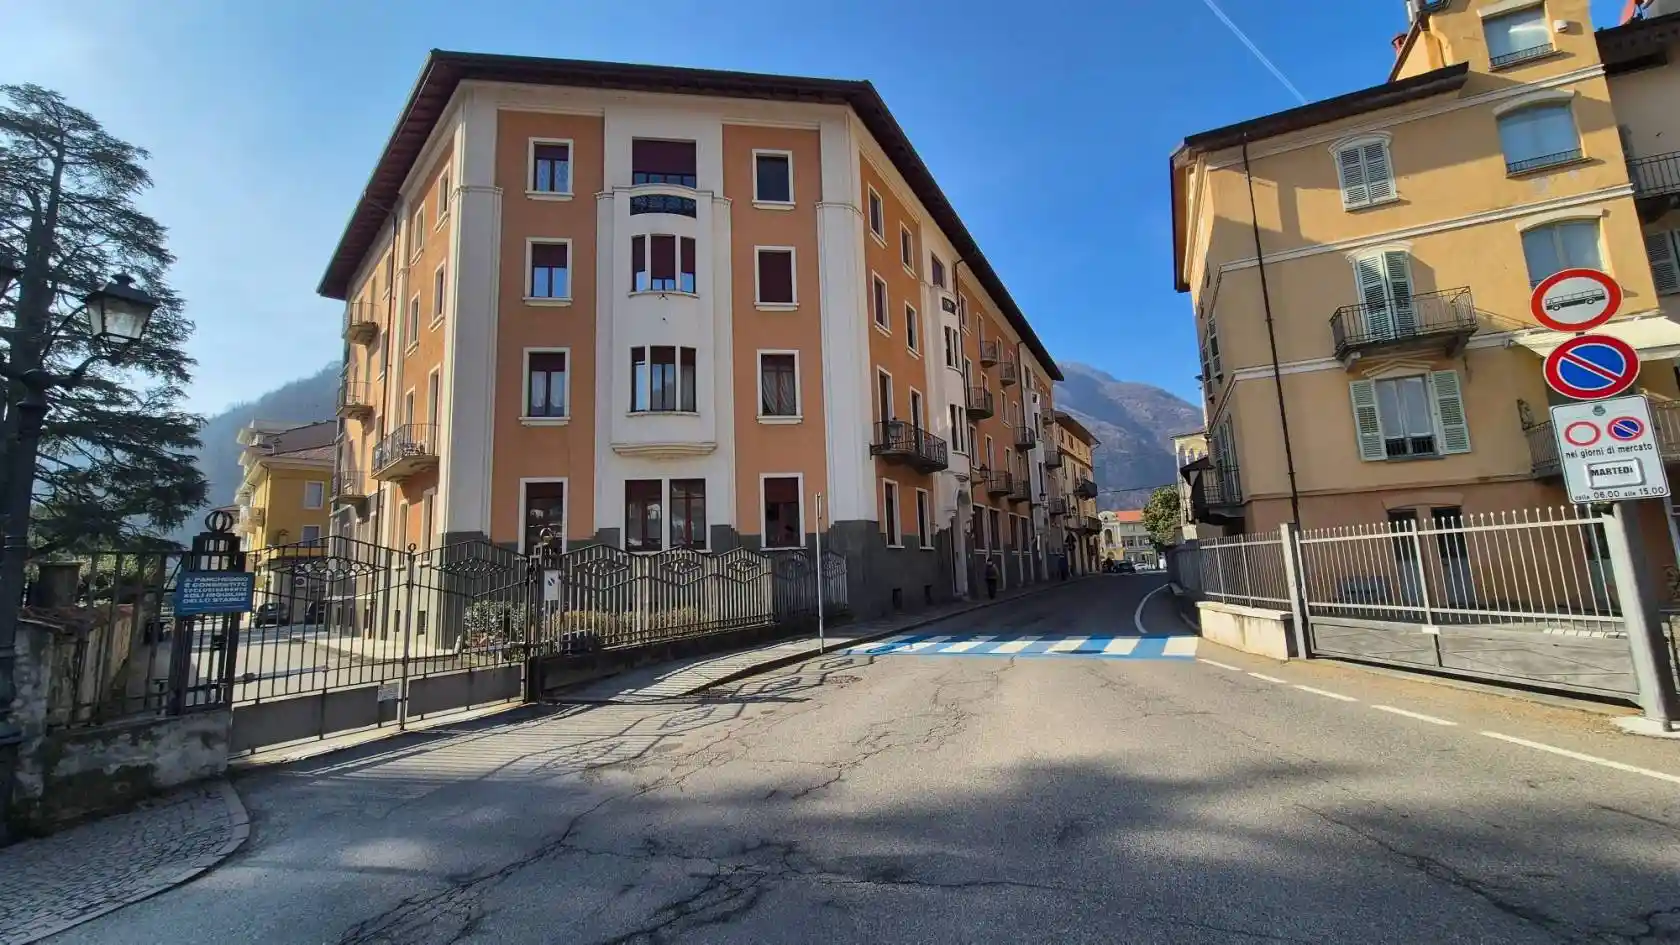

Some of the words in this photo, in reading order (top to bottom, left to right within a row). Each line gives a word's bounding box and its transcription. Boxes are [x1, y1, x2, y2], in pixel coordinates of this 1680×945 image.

[1565, 450, 1578, 459] nei
[1580, 447, 1604, 459] giorni
[1606, 445, 1615, 455] di
[1617, 442, 1653, 453] mercato
[1638, 486, 1665, 496] 15.00
